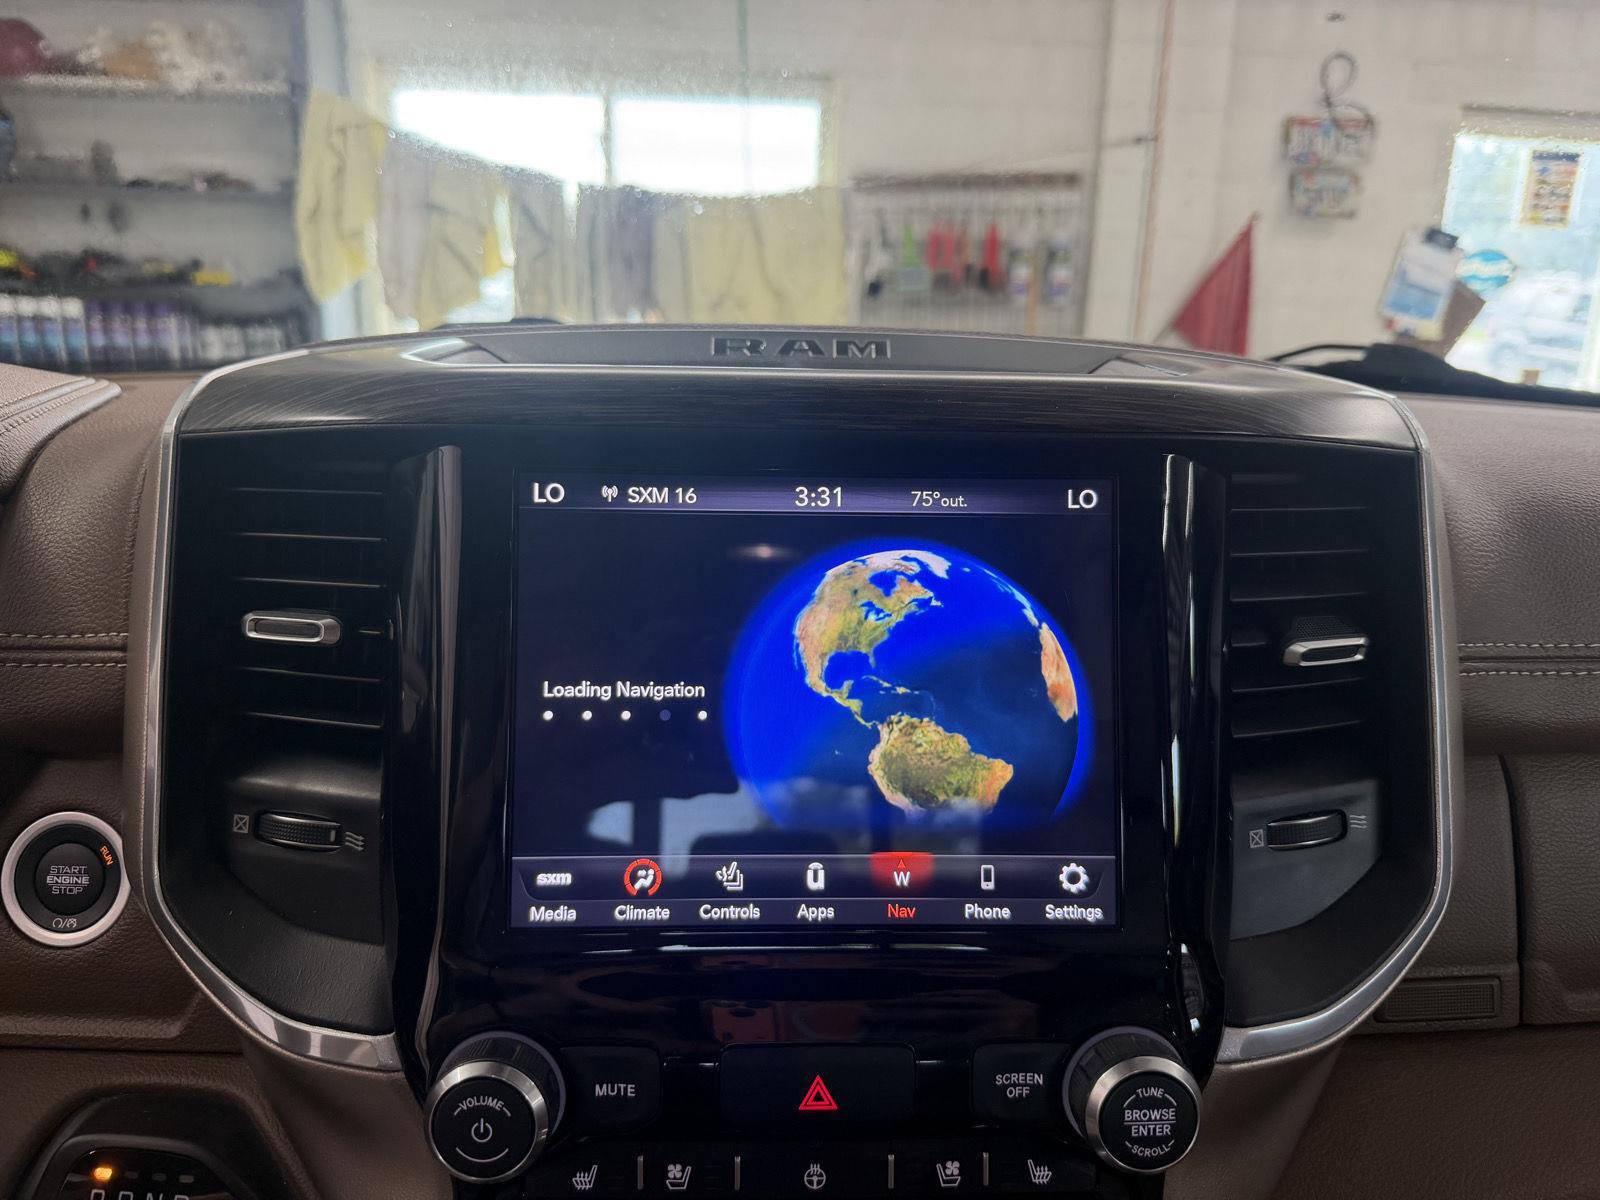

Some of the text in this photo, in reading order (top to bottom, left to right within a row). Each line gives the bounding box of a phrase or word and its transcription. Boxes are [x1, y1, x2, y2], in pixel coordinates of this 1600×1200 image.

[710, 336, 892, 359] RAM
[533, 482, 565, 503] LO
[627, 486, 697, 504] SXM 16
[794, 486, 843, 507] 3:31
[1067, 489, 1098, 509] LO
[543, 680, 706, 701] Loading Navigation
[100, 845, 114, 866] RUN
[49, 865, 87, 874] START
[46, 875, 90, 885] ENGINE
[536, 871, 573, 886] sxm
[893, 870, 911, 887] W
[51, 885, 83, 895] STOP
[529, 904, 577, 923] Media
[614, 904, 671, 921] Climate
[699, 902, 761, 920] Controls
[796, 903, 835, 922] Apps
[887, 903, 916, 918] Nav
[964, 902, 1012, 920] Phone
[1045, 903, 1105, 923] Settings
[995, 1072, 1044, 1086] SCREEN
[595, 1083, 636, 1097] MUTE
[1006, 1086, 1030, 1098] OFF
[1136, 1086, 1165, 1099] TUNE
[459, 1095, 505, 1111] VOLUME
[1124, 1108, 1176, 1121] BROWSE
[1131, 1124, 1172, 1137] ENTER
[1131, 1143, 1171, 1158] SCROLL
